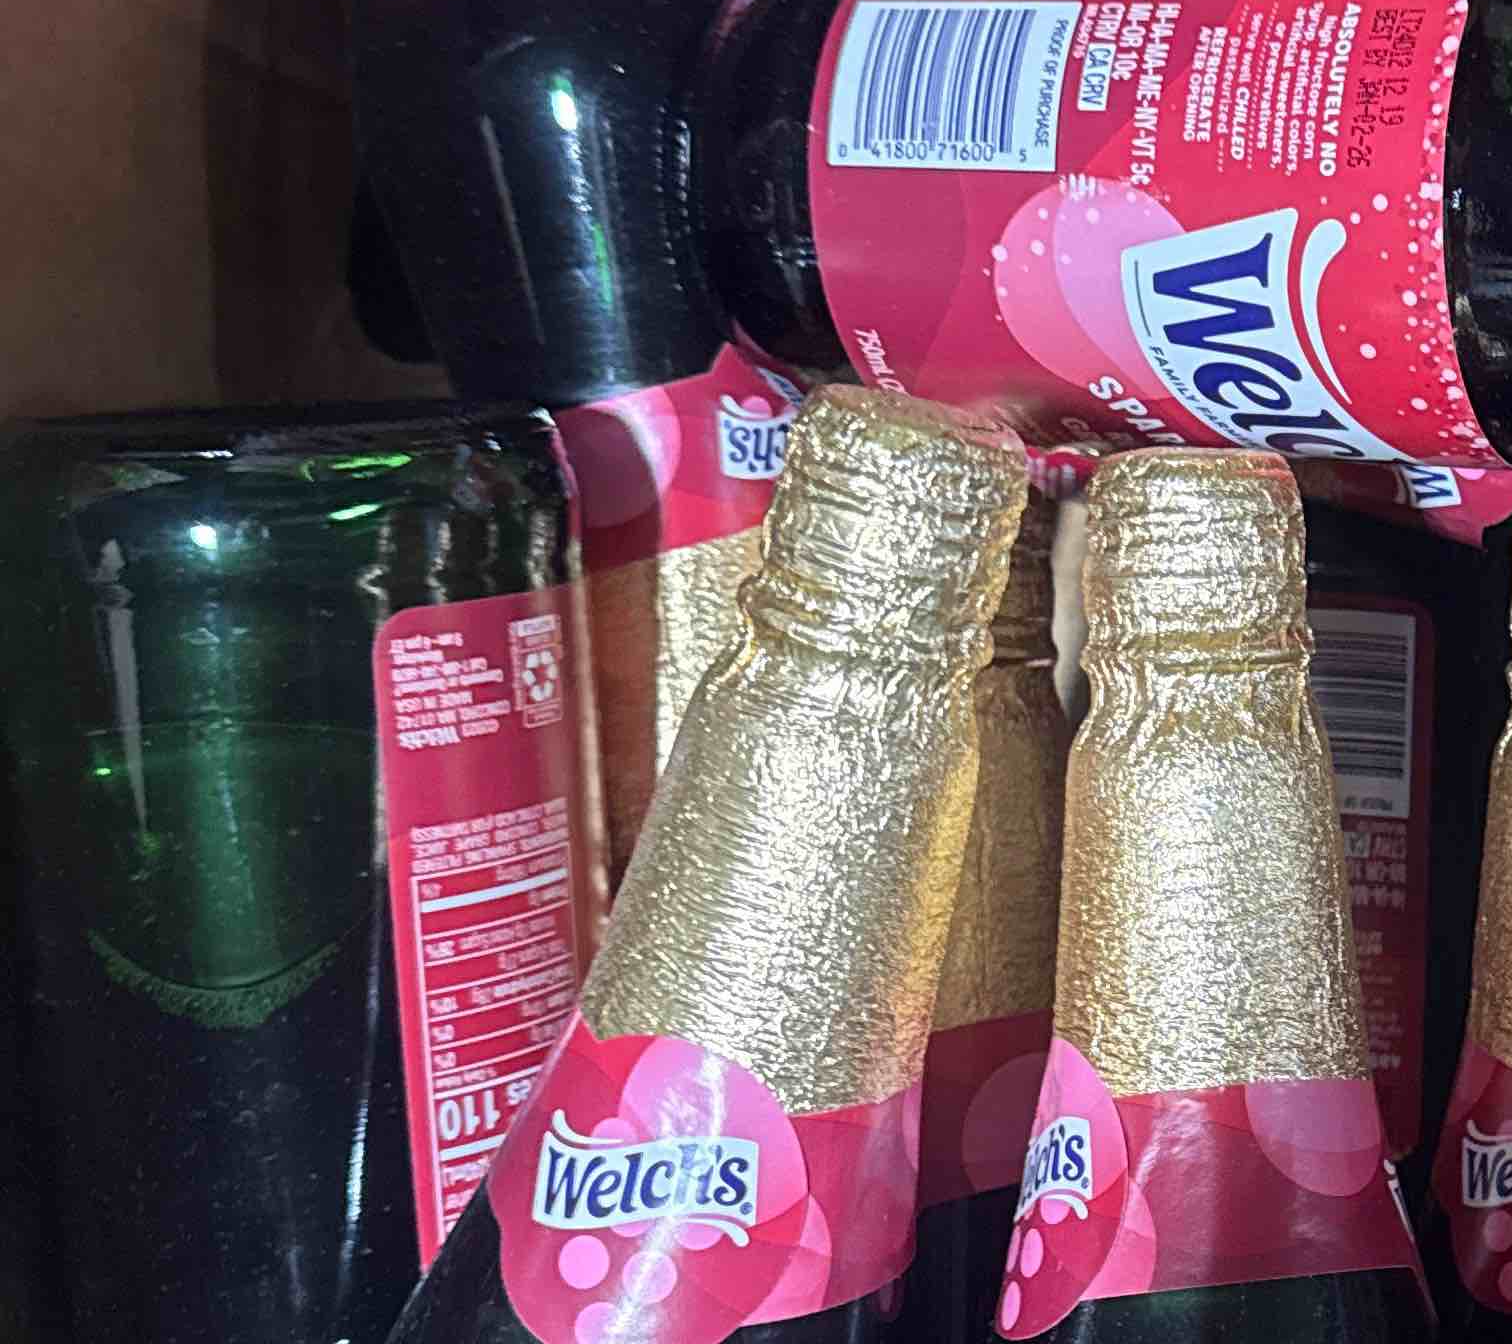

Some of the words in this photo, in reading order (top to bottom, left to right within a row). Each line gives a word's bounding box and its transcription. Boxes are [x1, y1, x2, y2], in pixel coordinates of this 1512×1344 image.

[1092, 1, 1125, 41] CTRV
[1119, 2, 1153, 47] MI-OR
[1191, 26, 1210, 69] AFTER
[1247, 12, 1263, 48] serve
[1281, 7, 1306, 67] artificial
[1302, 1, 1324, 44] syrup,
[1317, 15, 1337, 47] high
[1041, 59, 1057, 75] OF
[1087, 47, 1111, 69] CA
[1111, 50, 1139, 80] 10¢
[1196, 26, 1227, 142] REFRIGERATE
[1216, 36, 1242, 133] pasteurized
[1239, 51, 1254, 82] well
[1290, 48, 1316, 115] artificial
[1306, 50, 1329, 116] fructose
[1322, 2, 1360, 135] ABSOLUTELY
[1034, 79, 1056, 147] PURCHASE
[1080, 73, 1106, 105] CRV
[1182, 73, 1202, 141] OPENING
[1256, 42, 1283, 148] preservatives
[1231, 87, 1249, 160] CHILLED
[1269, 71, 1293, 168] sweeteners,
[1285, 119, 1301, 175] colors,
[1319, 142, 1336, 176] NO
[1150, 345, 1199, 404] FAMILY
[1152, 232, 1365, 459] Welc
[727, 422, 792, 474] ch's
[543, 1141, 752, 1220] Welch's
[1020, 1123, 1087, 1206] lch's
